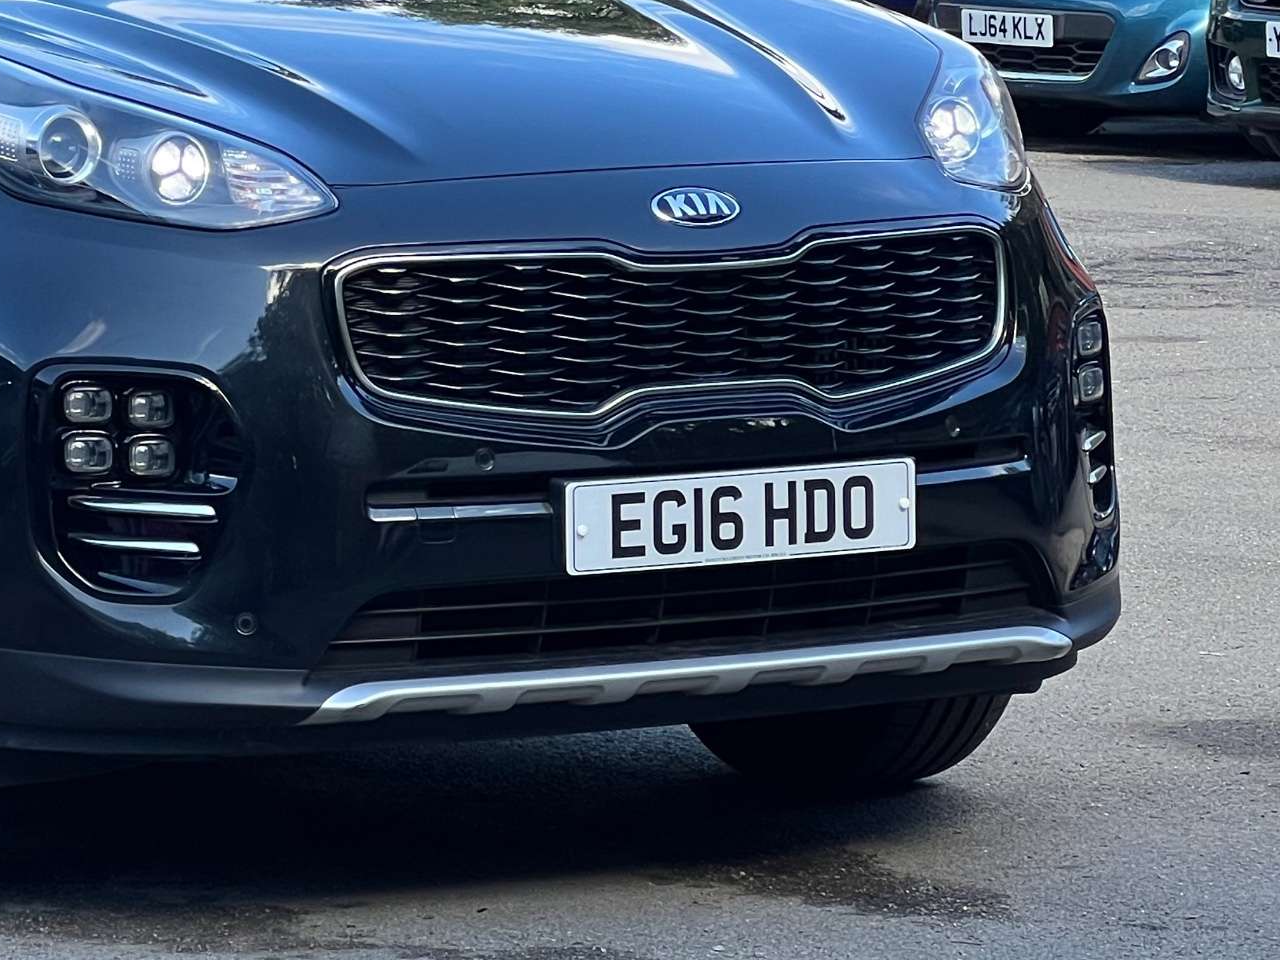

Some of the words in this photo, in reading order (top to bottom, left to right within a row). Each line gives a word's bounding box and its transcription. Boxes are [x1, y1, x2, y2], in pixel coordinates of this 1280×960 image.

[968, 12, 1008, 39] LJ64
[1012, 15, 1046, 41] KLX
[663, 192, 732, 218] KIA
[610, 485, 745, 560] EG16
[764, 474, 875, 548] HDO
